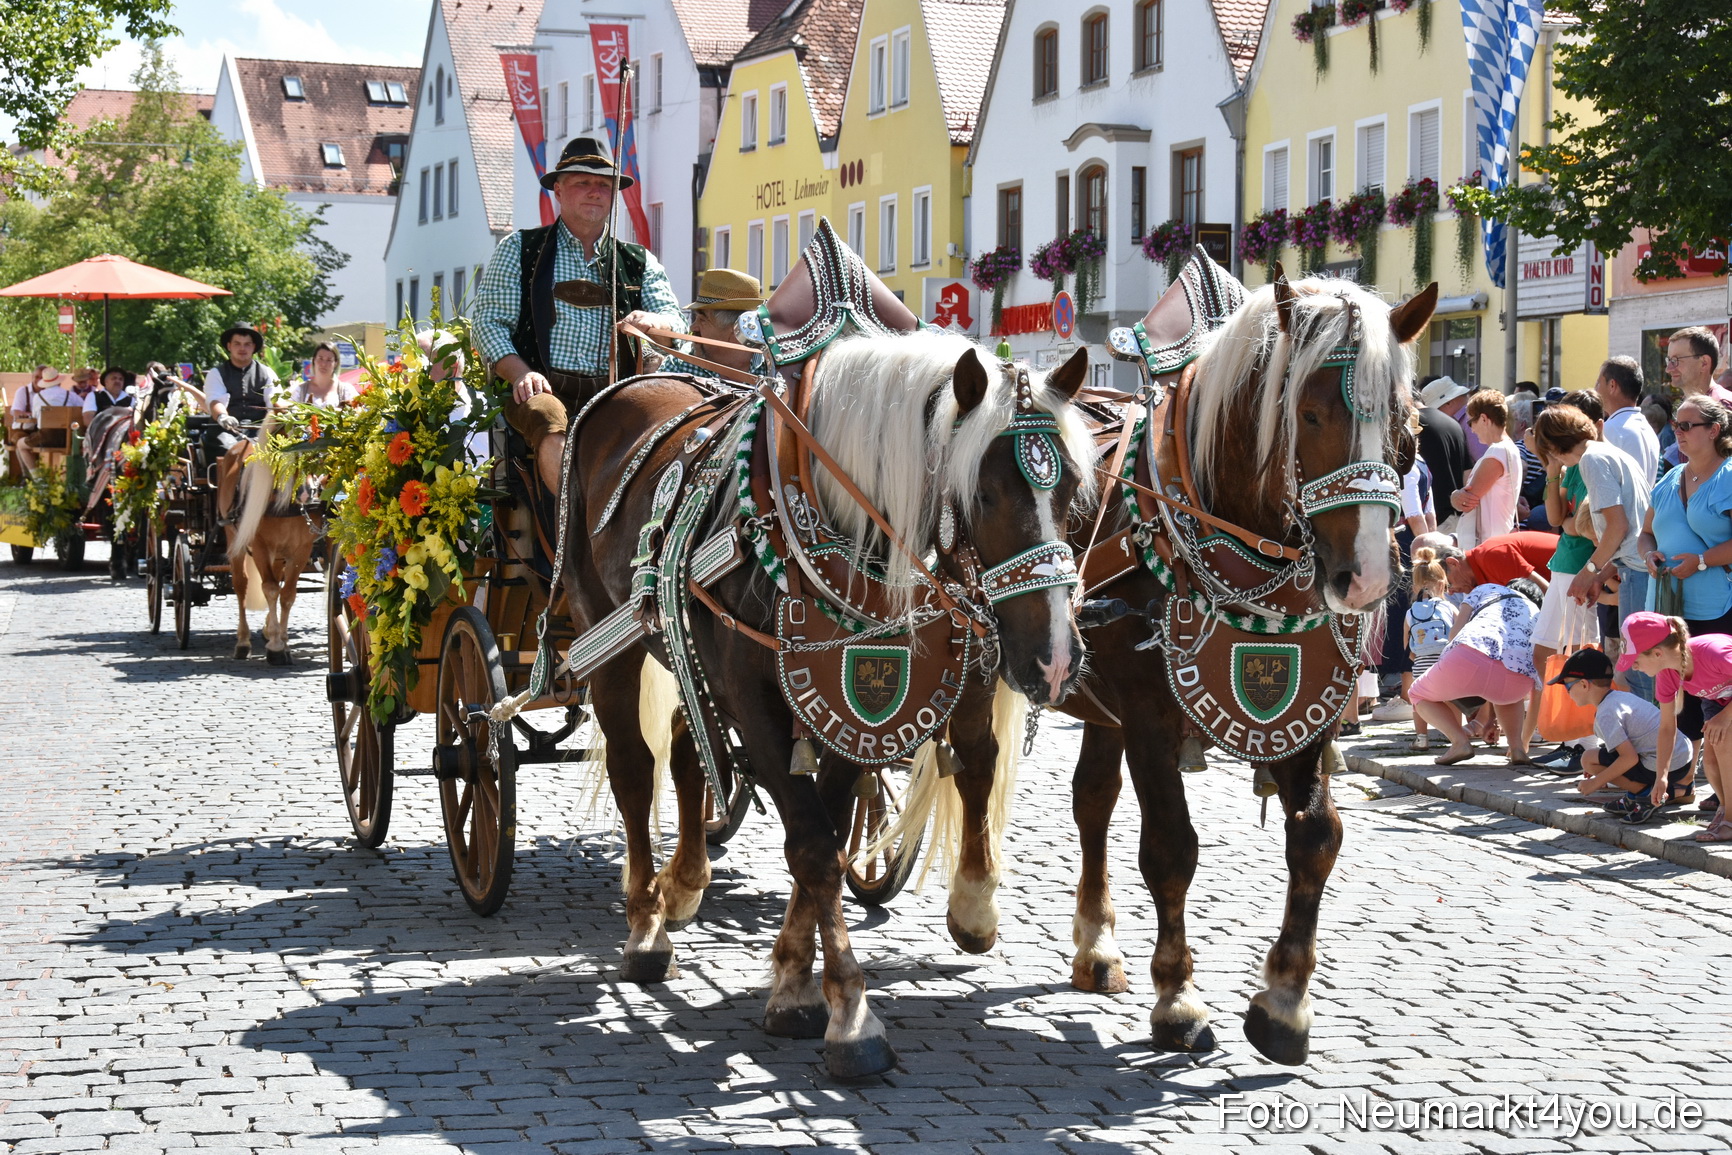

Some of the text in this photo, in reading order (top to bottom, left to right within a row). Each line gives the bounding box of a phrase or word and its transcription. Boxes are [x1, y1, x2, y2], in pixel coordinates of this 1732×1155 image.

[598, 31, 619, 84] K&L
[756, 177, 830, 210] HOTEL Lehmeier
[1523, 257, 1574, 280] RIALTO KINO
[787, 667, 960, 758] DIETERSDORF
[1175, 665, 1351, 755] DIETERSDORF
